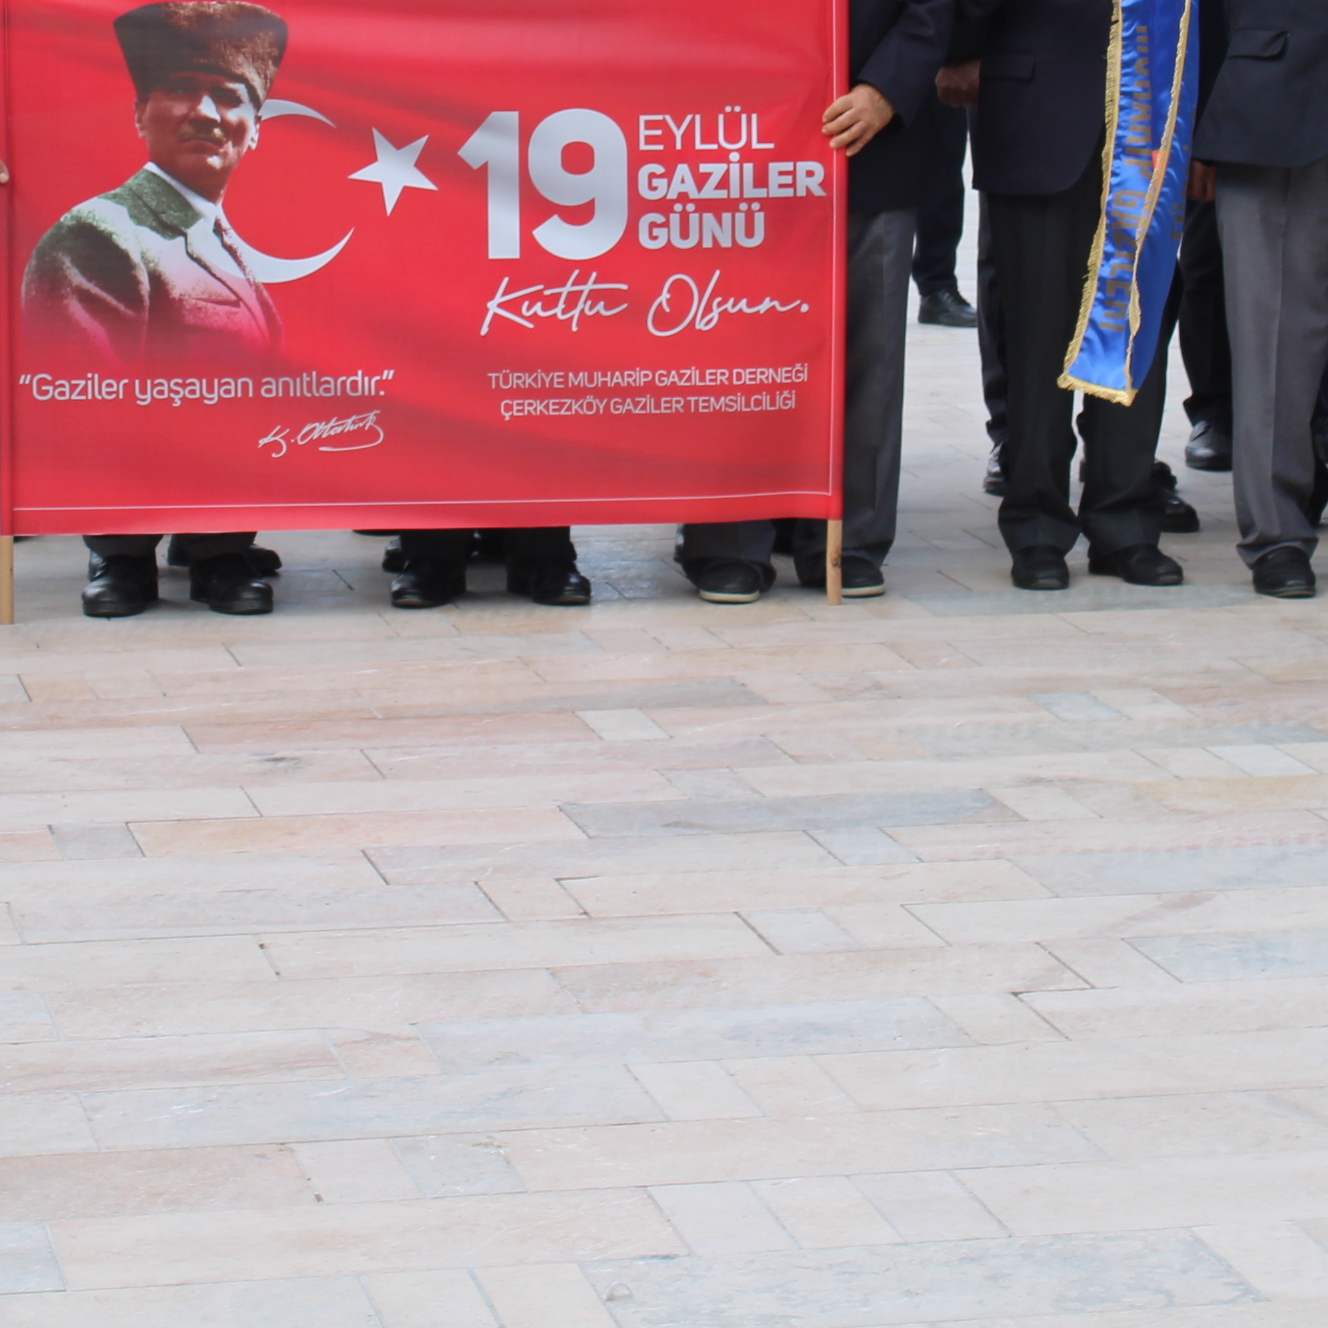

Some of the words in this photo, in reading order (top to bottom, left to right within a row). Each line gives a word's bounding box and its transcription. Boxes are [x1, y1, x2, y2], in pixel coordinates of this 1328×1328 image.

[457, 107, 629, 260] 19
[638, 105, 775, 151] EYLÜL
[637, 151, 827, 201] GAZİLER
[638, 201, 765, 250] GÜNÜ
[646, 269, 810, 337] Olsun.
[134, 377, 254, 407] yaşayan
[487, 367, 565, 390] TÜRKİYE
[567, 366, 652, 389] MUHARİP
[654, 365, 730, 387] GAZİLER
[732, 362, 809, 385] DERNEĞİ
[500, 394, 608, 421] ÇERKEZKÖY
[610, 393, 685, 415] GAZİLER
[686, 390, 797, 413] TEMSİLCİLİĞİ
